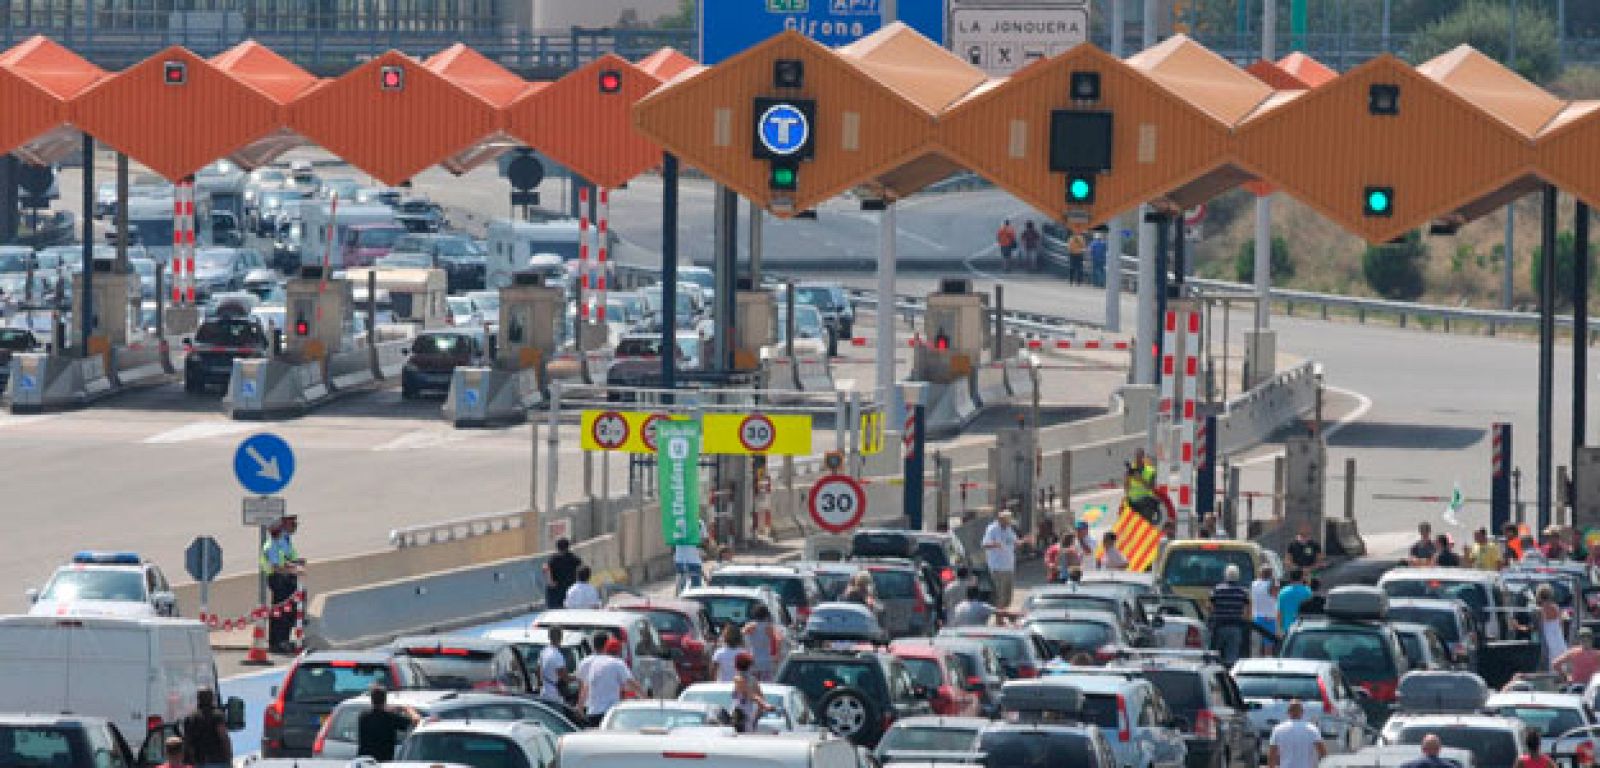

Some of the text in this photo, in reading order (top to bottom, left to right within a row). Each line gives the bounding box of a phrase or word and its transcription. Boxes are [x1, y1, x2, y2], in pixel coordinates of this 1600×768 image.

[784, 16, 863, 36] Girona
[959, 20, 1079, 34] LA JONQUERA
[769, 117, 798, 144] T
[747, 425, 769, 440] 30
[820, 492, 854, 513] 30
[672, 519, 687, 539] La
